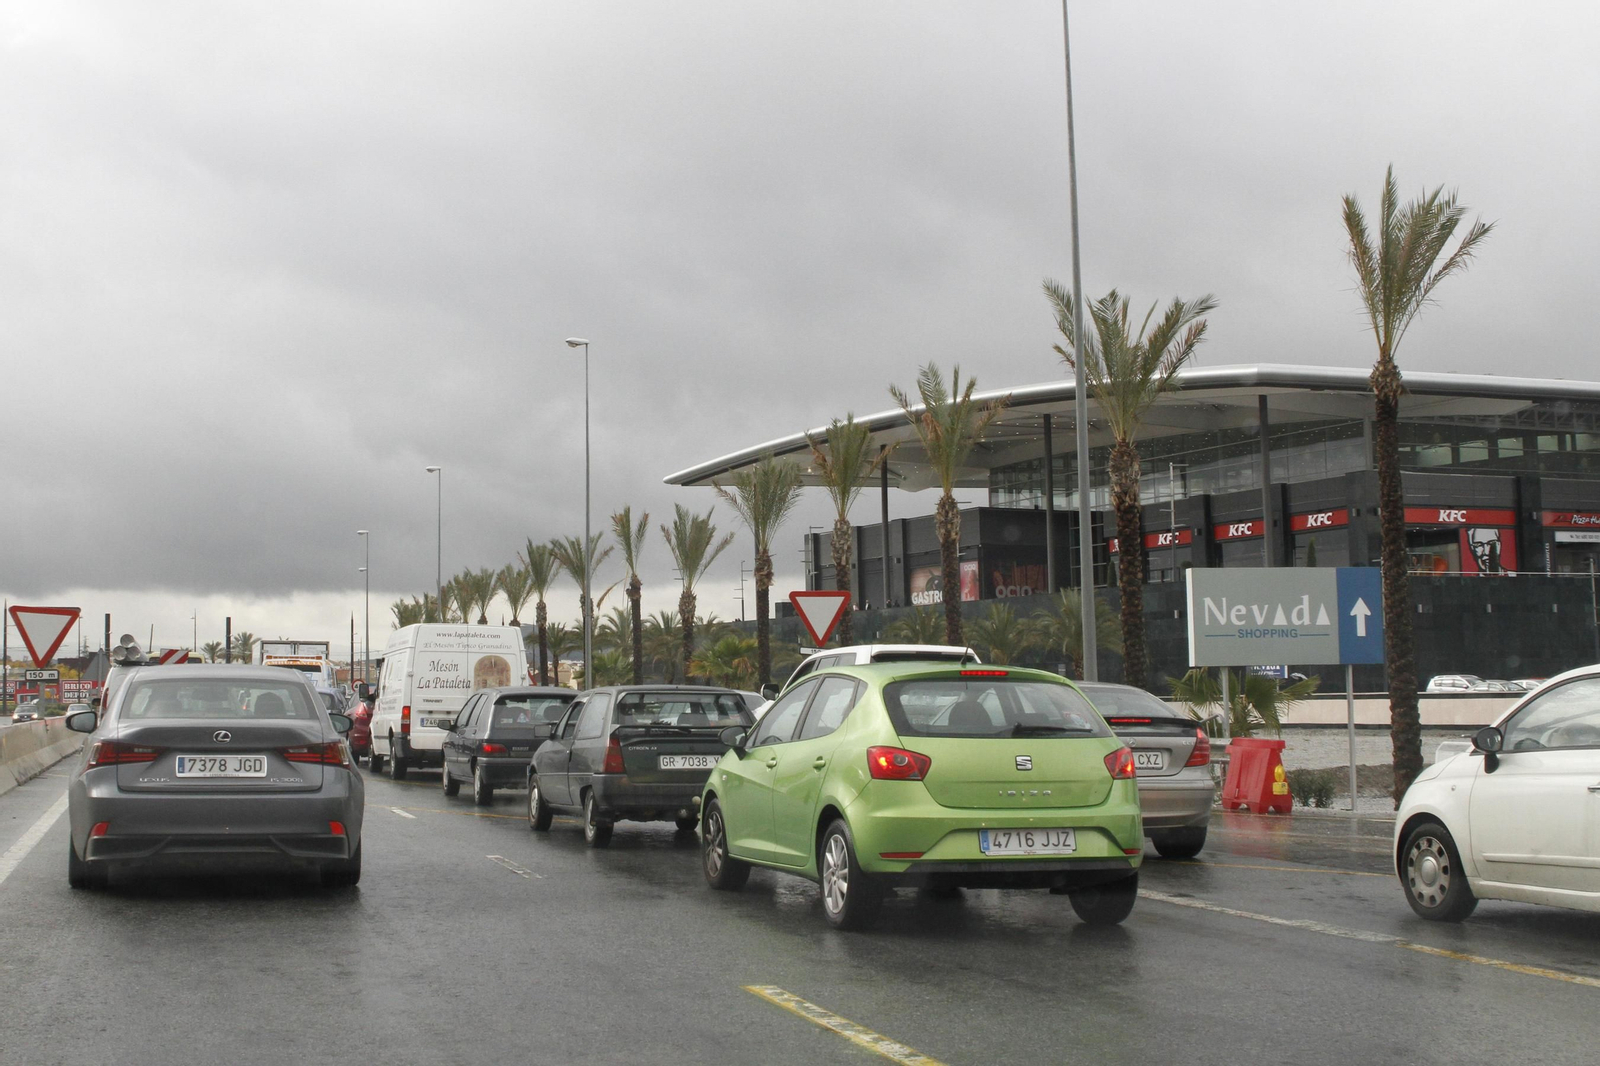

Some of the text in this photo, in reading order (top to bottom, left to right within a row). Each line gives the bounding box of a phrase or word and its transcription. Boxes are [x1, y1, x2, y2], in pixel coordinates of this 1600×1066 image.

[1306, 512, 1333, 527] KFC
[1438, 509, 1467, 522] KFC
[1571, 514, 1600, 524] Pizza Hu
[1228, 523, 1252, 537] KFC
[1157, 532, 1180, 545] KFC
[995, 585, 1032, 598] OCIO
[1202, 594, 1331, 626] Nevada
[436, 631, 501, 640] www.lapataleta.com
[1237, 628, 1298, 639] SHOPPING
[429, 659, 459, 672] Mesón
[417, 676, 471, 689] La Pataleta
[188, 758, 263, 772] 7378 JGD
[1138, 754, 1160, 766] CXZ
[992, 831, 1072, 849] 4716 JJZ
